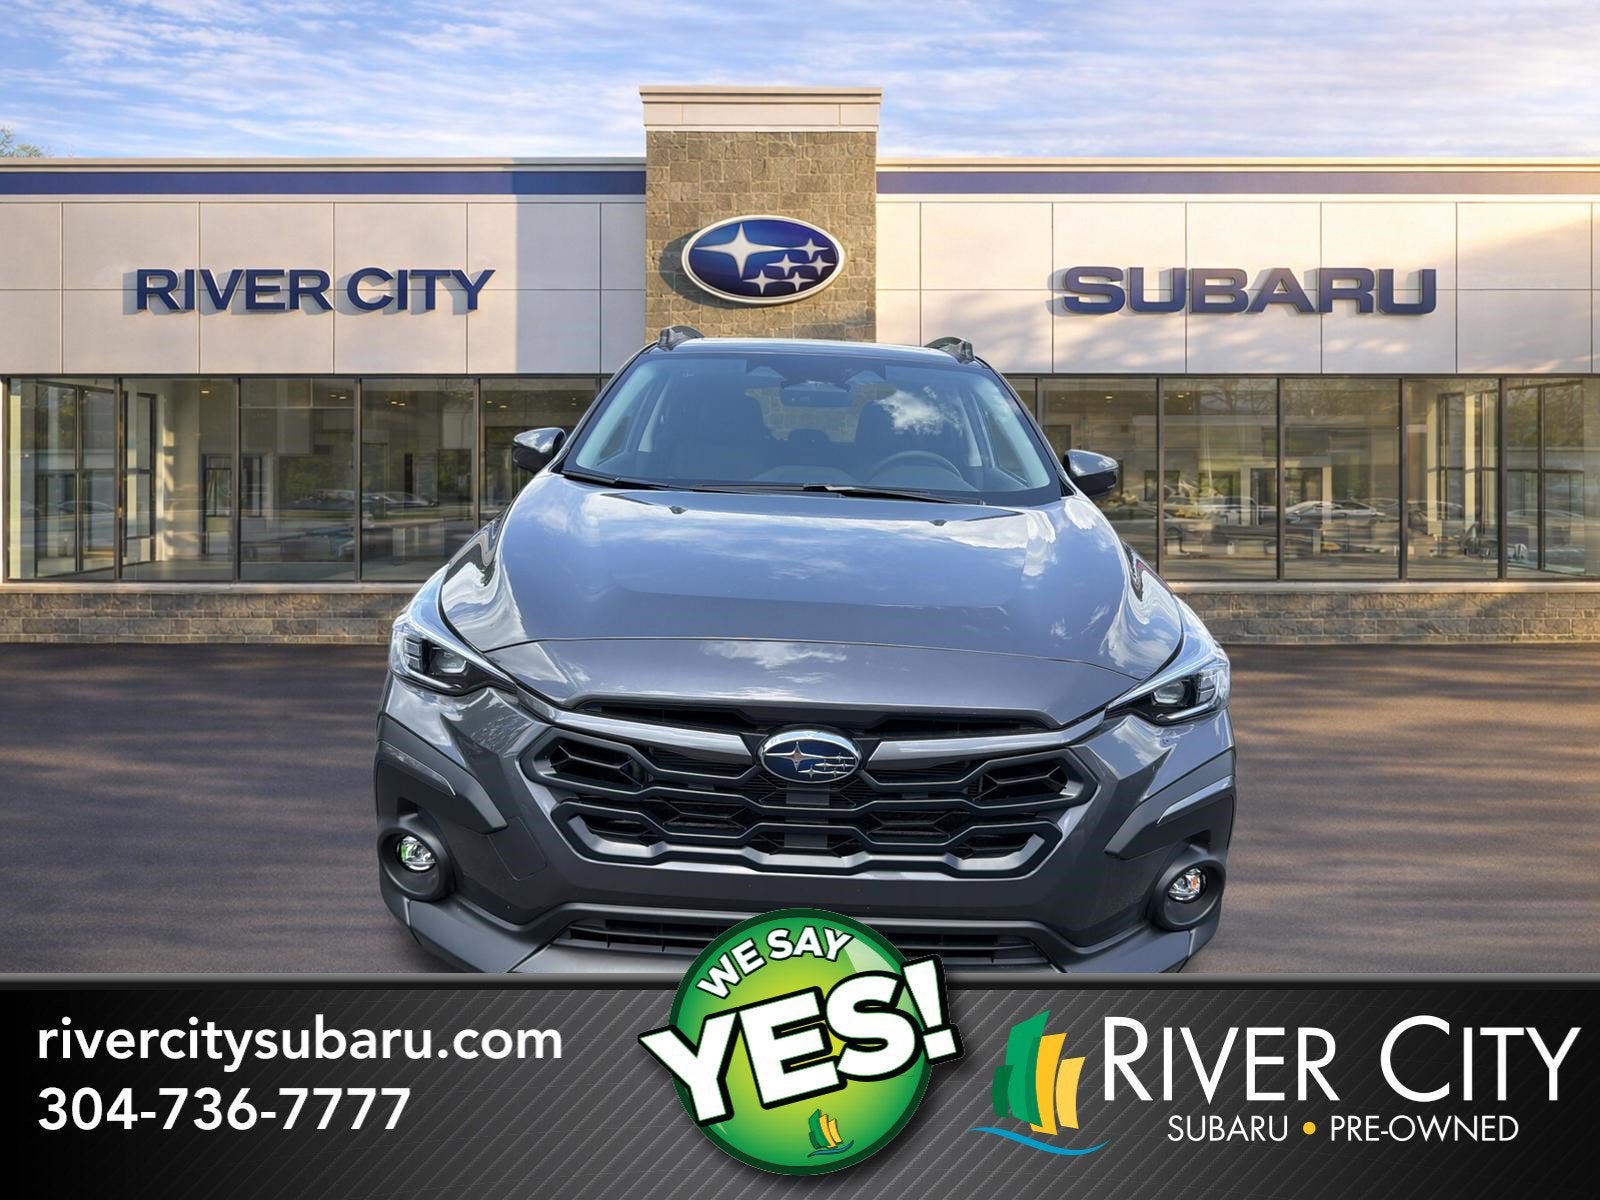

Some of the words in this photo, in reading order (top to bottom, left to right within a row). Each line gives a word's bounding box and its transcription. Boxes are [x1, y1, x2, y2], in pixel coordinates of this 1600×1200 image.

[136, 268, 333, 310] RIVER
[347, 267, 495, 310] CITY
[1062, 266, 1436, 315] SUBARU
